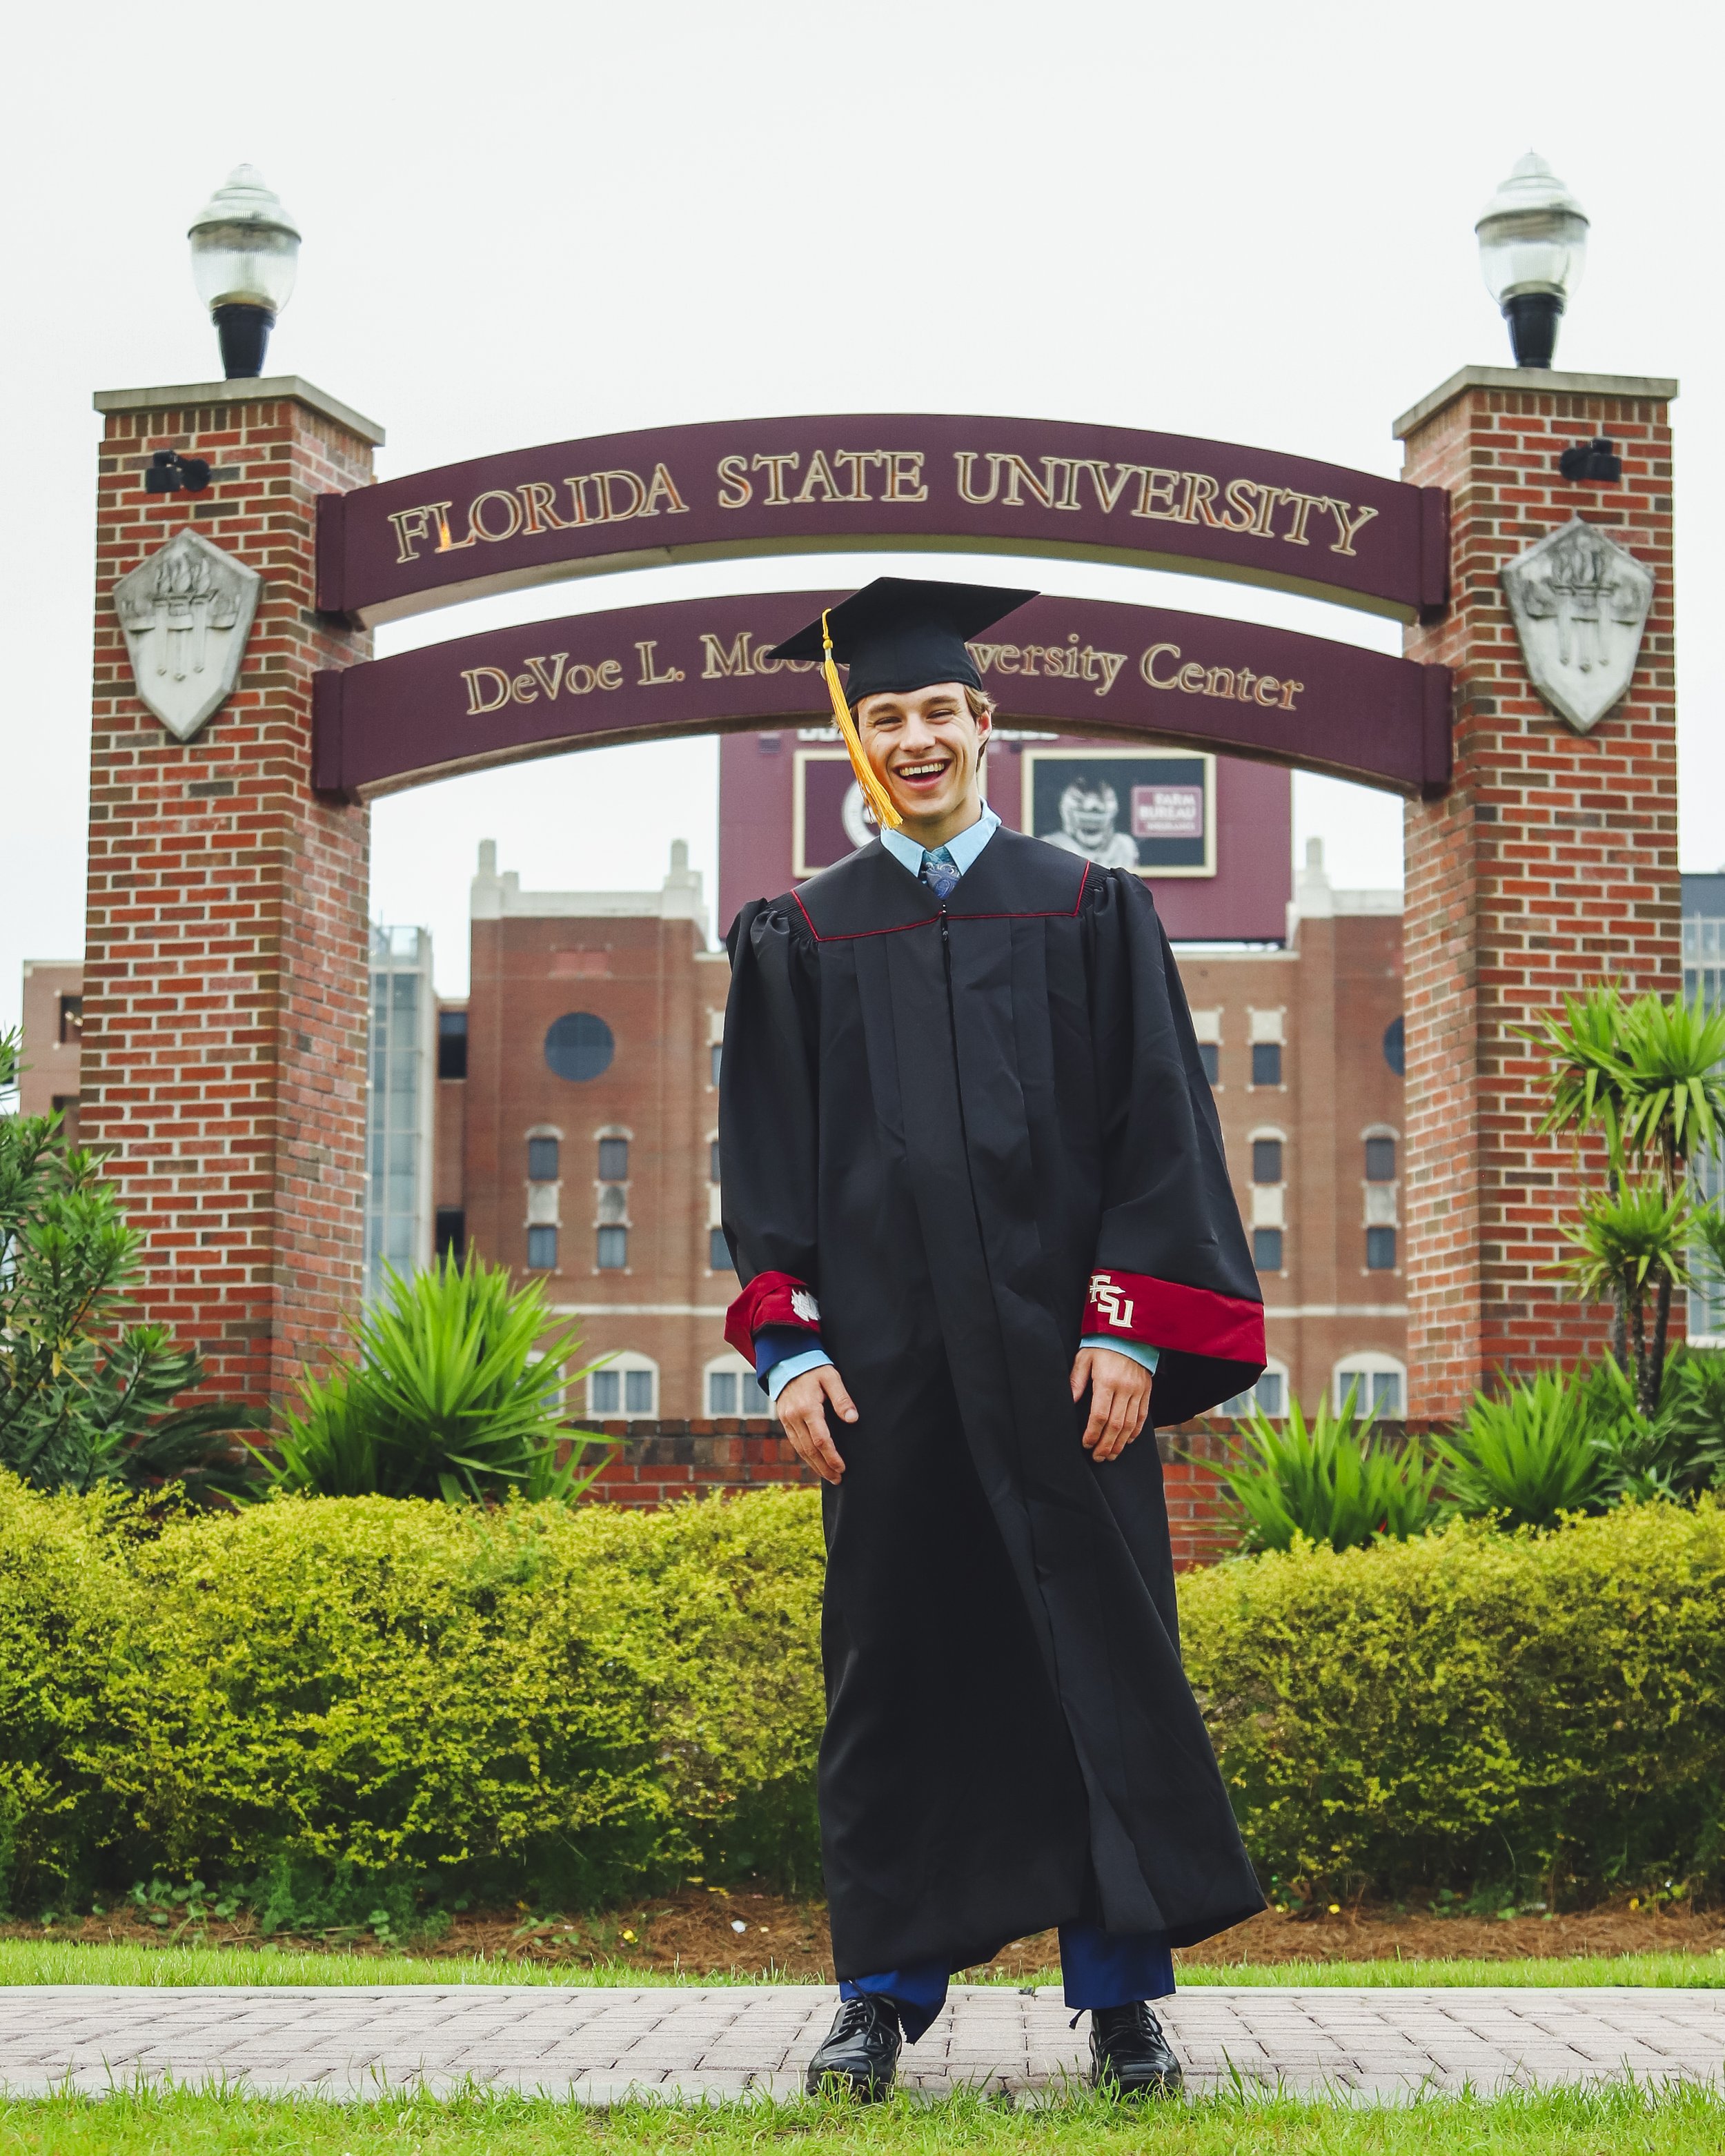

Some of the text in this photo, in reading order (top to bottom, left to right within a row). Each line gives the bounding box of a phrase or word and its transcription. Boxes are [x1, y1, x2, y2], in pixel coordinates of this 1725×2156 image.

[387, 449, 1379, 564] FLORIDA STATE UNIVERSITY
[462, 652, 622, 715] DeVoe
[635, 641, 686, 686] L.
[964, 633, 1127, 695] versity
[1140, 643, 1304, 711] Center
[1090, 1274, 1134, 1328] FSU
